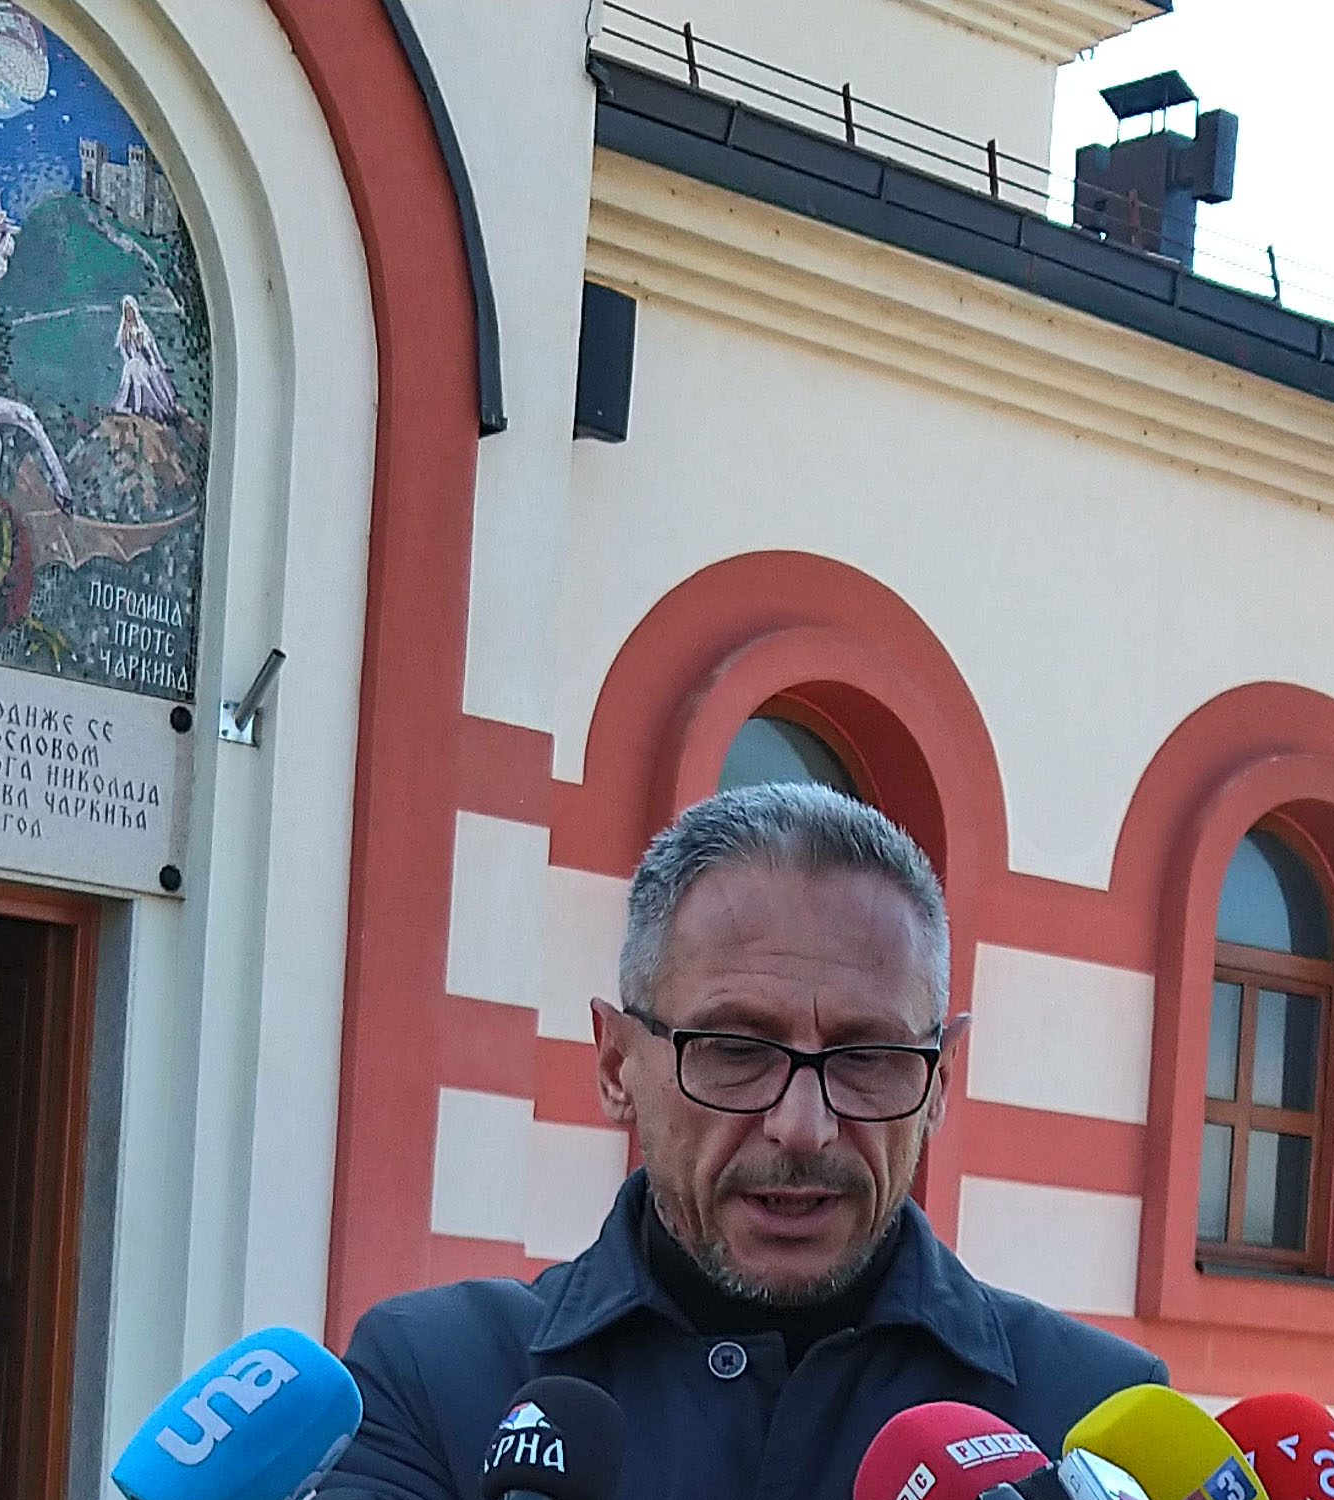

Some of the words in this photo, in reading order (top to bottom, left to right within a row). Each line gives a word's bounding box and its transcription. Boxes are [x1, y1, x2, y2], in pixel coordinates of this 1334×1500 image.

[89, 580, 183, 628] ПОРОДИЦА
[115, 620, 175, 657] ПРОТЕ
[88, 718, 114, 743] СЕ
[47, 763, 159, 807] НИКОЛАЈА
[44, 790, 147, 831] ЧАРКИЋА
[155, 1349, 300, 1465] una
